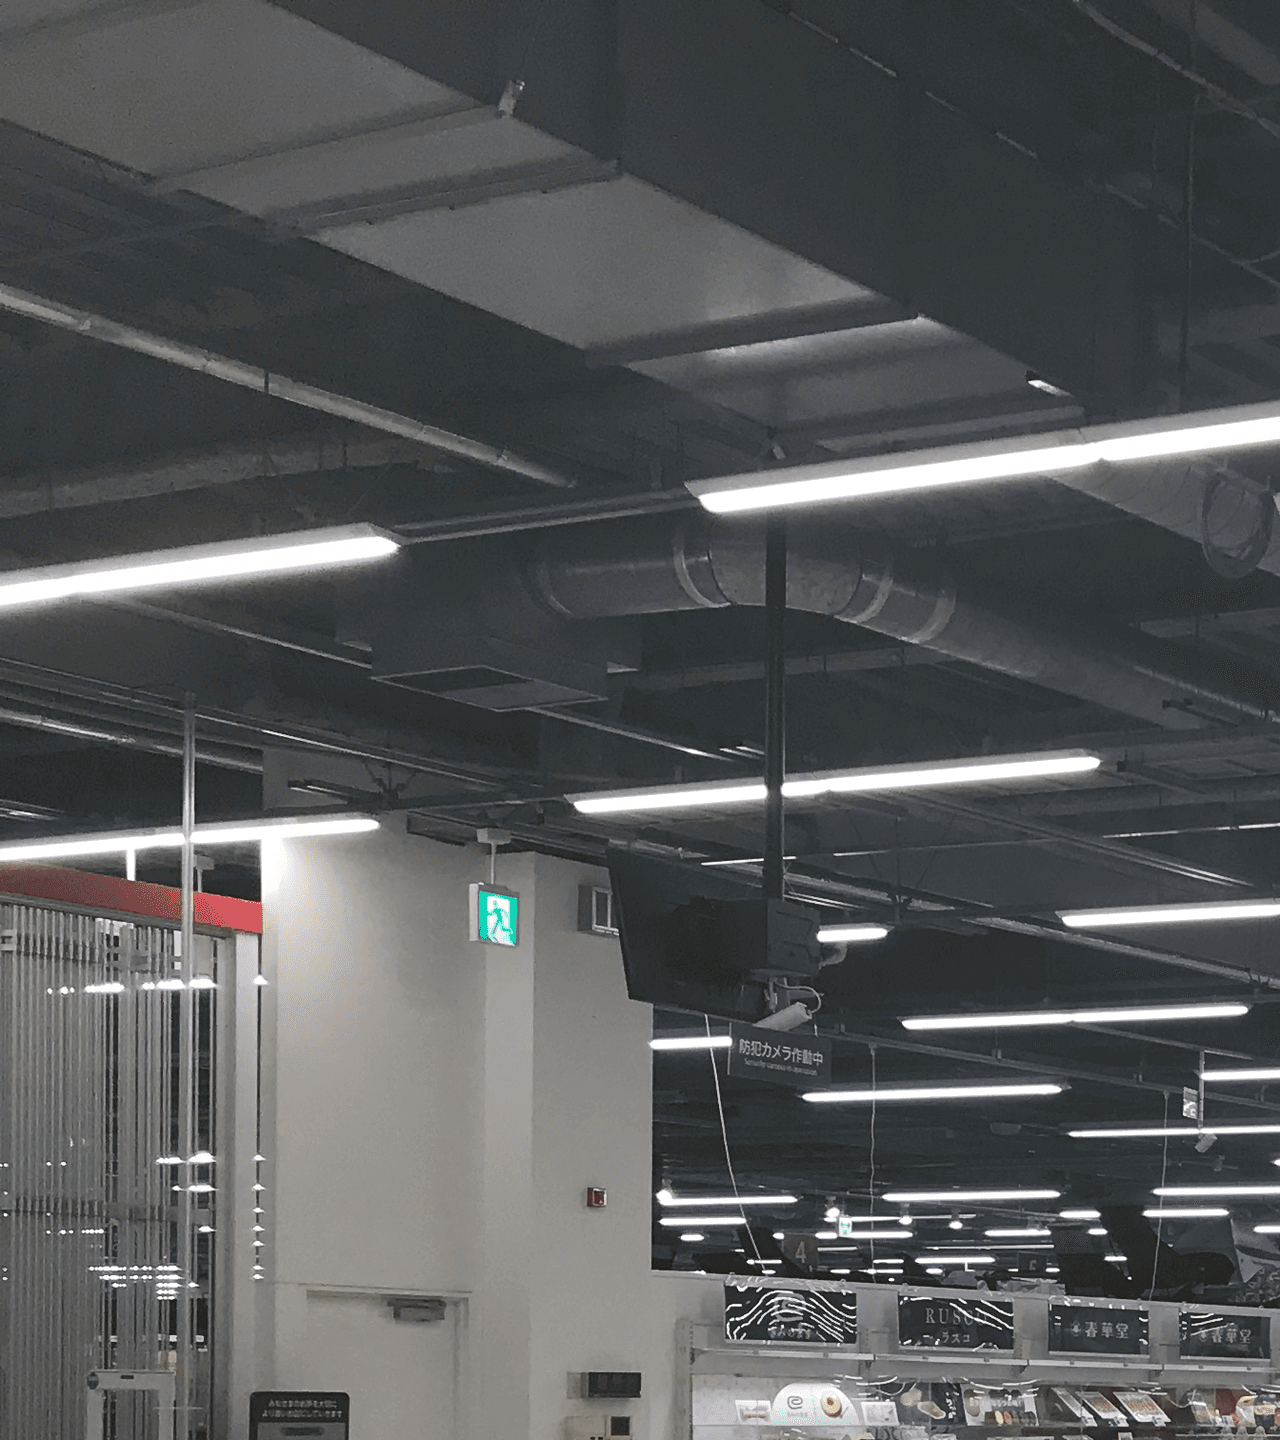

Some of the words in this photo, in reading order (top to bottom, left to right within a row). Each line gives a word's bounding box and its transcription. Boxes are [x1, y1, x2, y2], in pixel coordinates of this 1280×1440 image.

[739, 1039, 824, 1066] 防犯カメラ作動中
[926, 1308, 988, 1326] RUSCO
[942, 1333, 971, 1344] ラスコ
[1085, 1321, 1129, 1339] 春華堂
